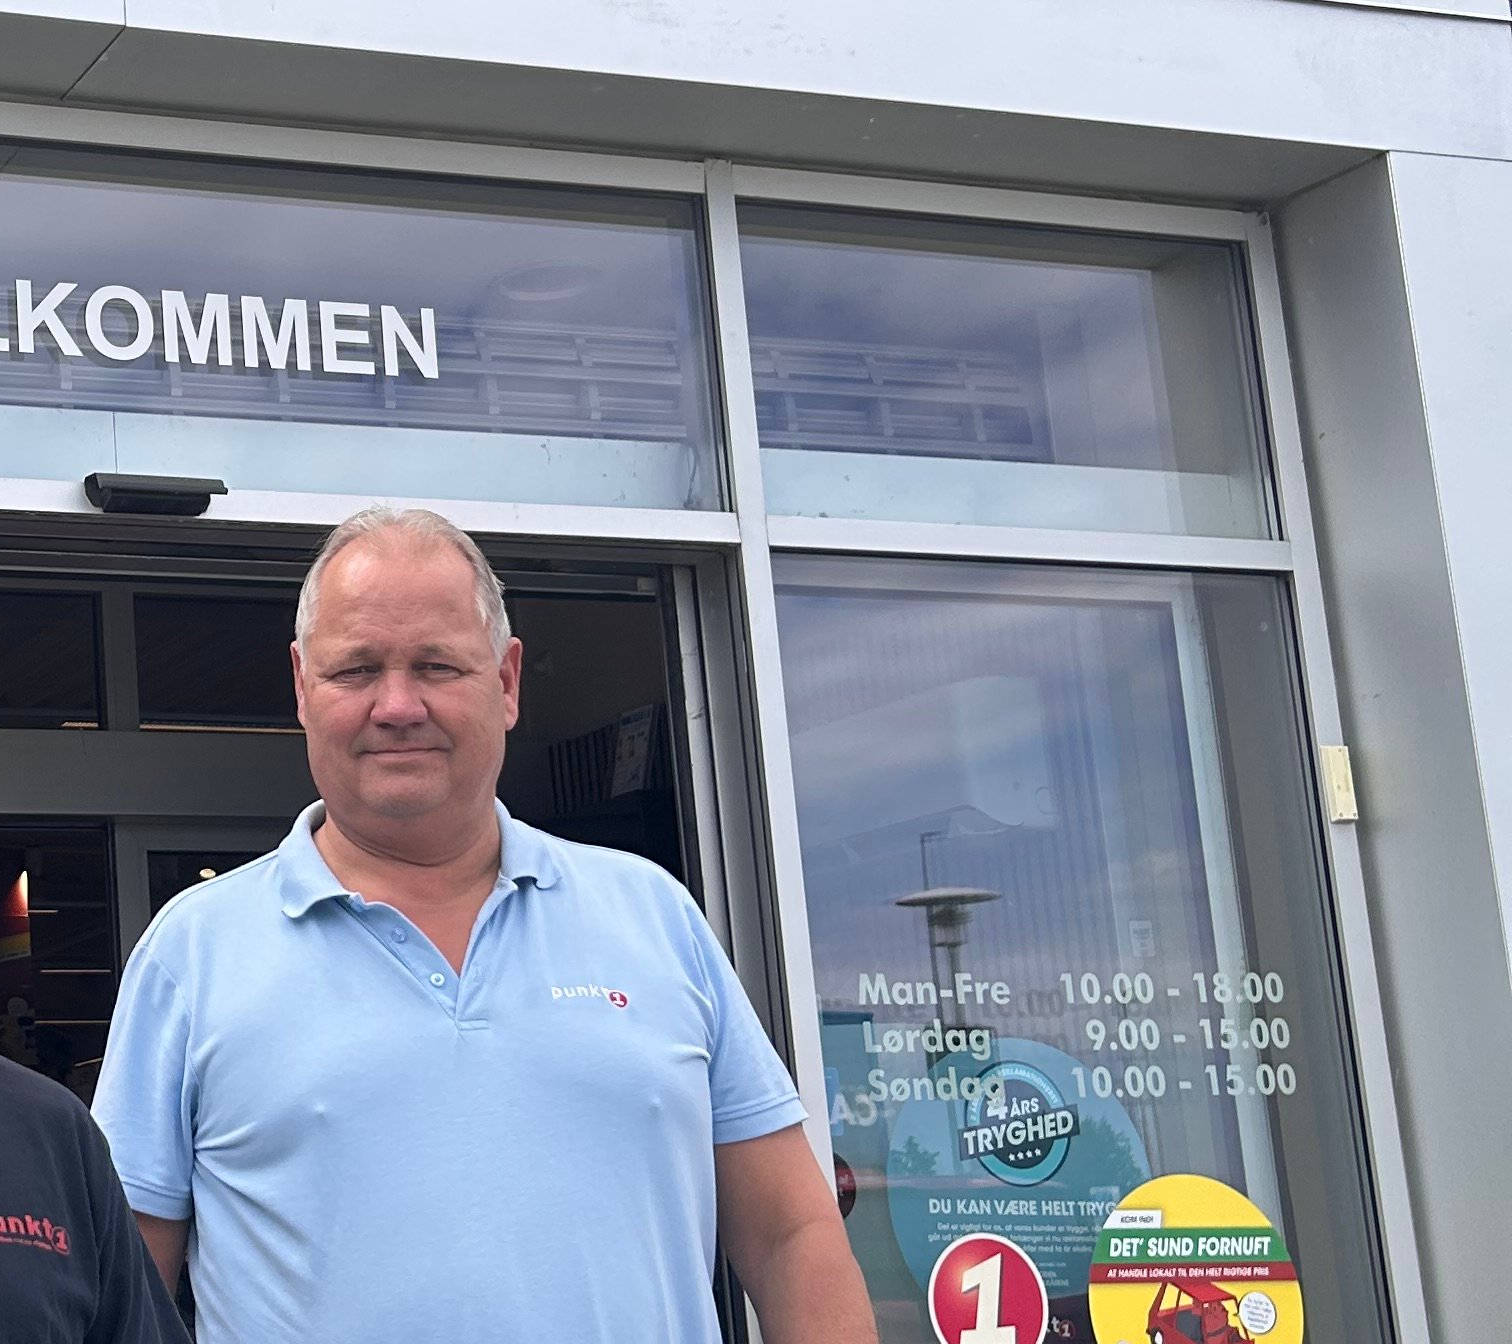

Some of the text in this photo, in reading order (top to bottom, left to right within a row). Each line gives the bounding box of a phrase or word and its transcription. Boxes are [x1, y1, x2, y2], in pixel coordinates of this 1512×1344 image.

[858, 973, 1011, 1005] Man-Fre
[1060, 972, 1154, 1004] 10.00
[1193, 972, 1284, 1004] 18.00
[863, 1019, 991, 1059] Lørdag
[1086, 1018, 1160, 1051] 9.00
[1199, 1018, 1290, 1051] 15.00
[867, 1066, 1004, 1106] Søndag
[1072, 1065, 1166, 1098] 10.00
[1205, 1063, 1297, 1096] 15.00
[1010, 1097, 1041, 1118] ÅRS
[963, 1110, 1075, 1155] TRYGHED
[929, 1198, 952, 1214] DU
[956, 1199, 992, 1215] KAN
[994, 1200, 1038, 1216] VÆRE
[1041, 1200, 1076, 1216] HELT
[1147, 1237, 1193, 1257] SUND
[1197, 1236, 1271, 1256] FORNUFT
